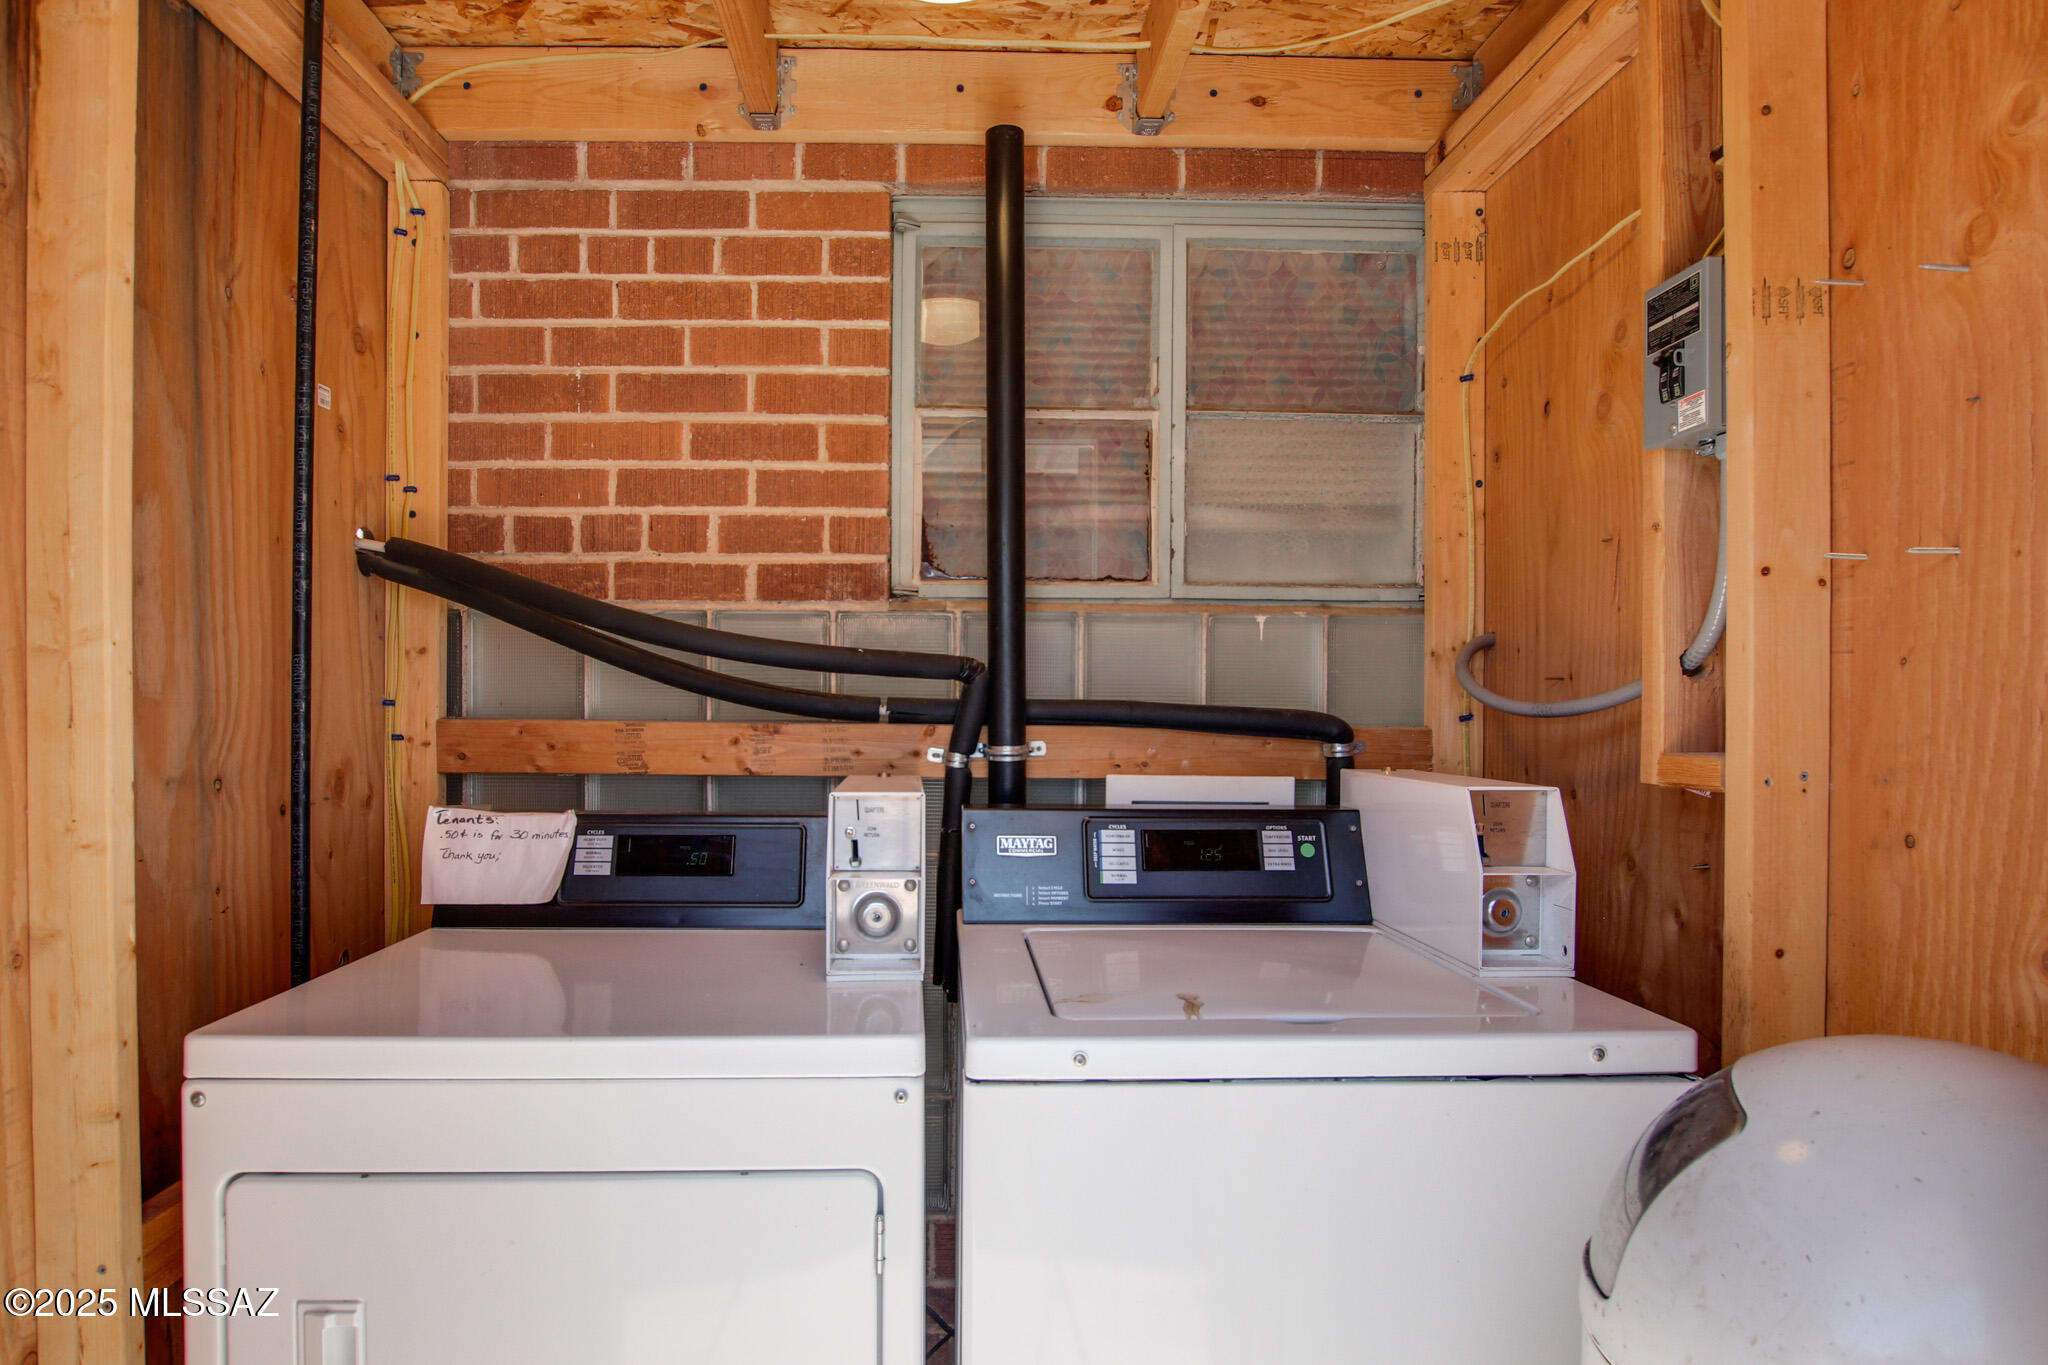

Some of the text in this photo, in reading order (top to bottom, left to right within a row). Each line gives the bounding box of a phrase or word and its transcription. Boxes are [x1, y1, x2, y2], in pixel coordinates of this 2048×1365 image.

[434, 809, 500, 825] Tenants:
[490, 830, 504, 840] for
[510, 828, 529, 840] 30
[1000, 838, 1053, 849] MAYTAG
[440, 848, 472, 860] Thank
[686, 852, 708, 865] .50
